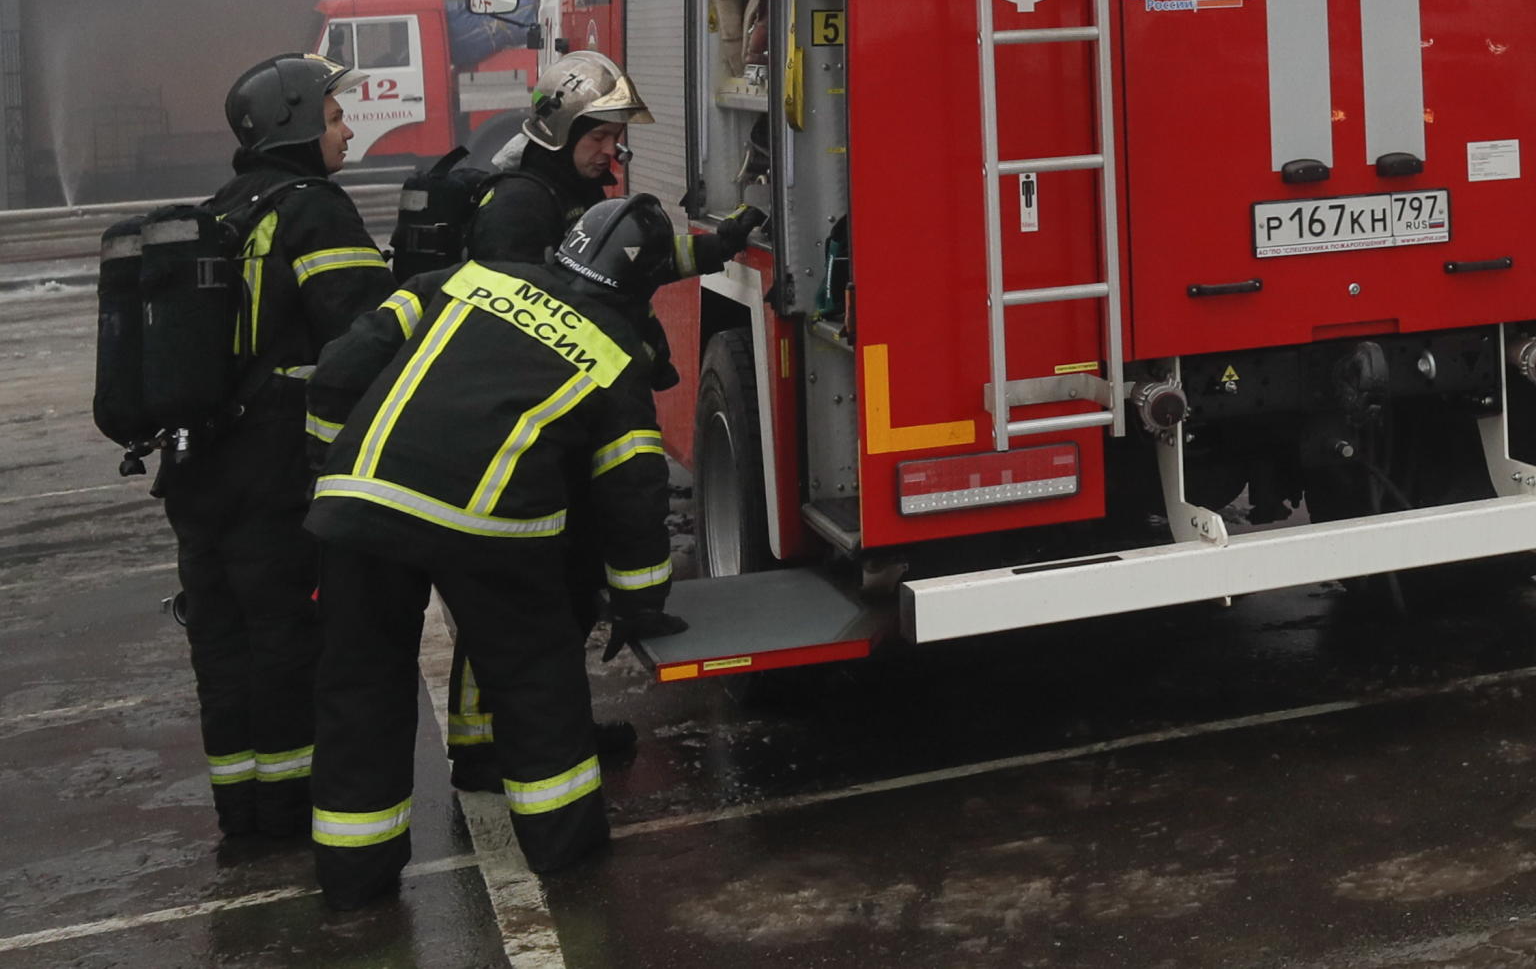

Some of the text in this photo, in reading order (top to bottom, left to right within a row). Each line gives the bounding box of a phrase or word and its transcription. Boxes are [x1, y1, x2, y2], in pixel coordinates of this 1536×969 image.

[1146, 0, 1194, 12] России
[823, 13, 840, 43] 5
[358, 78, 400, 102] 12
[562, 73, 584, 92] 71
[362, 110, 414, 121] КУПАВНА
[1266, 195, 1438, 241] Р167КН 797
[1405, 220, 1428, 230] RUS
[569, 230, 592, 254] 71
[514, 282, 583, 330] МЧС
[467, 286, 597, 373] РОССИИ
